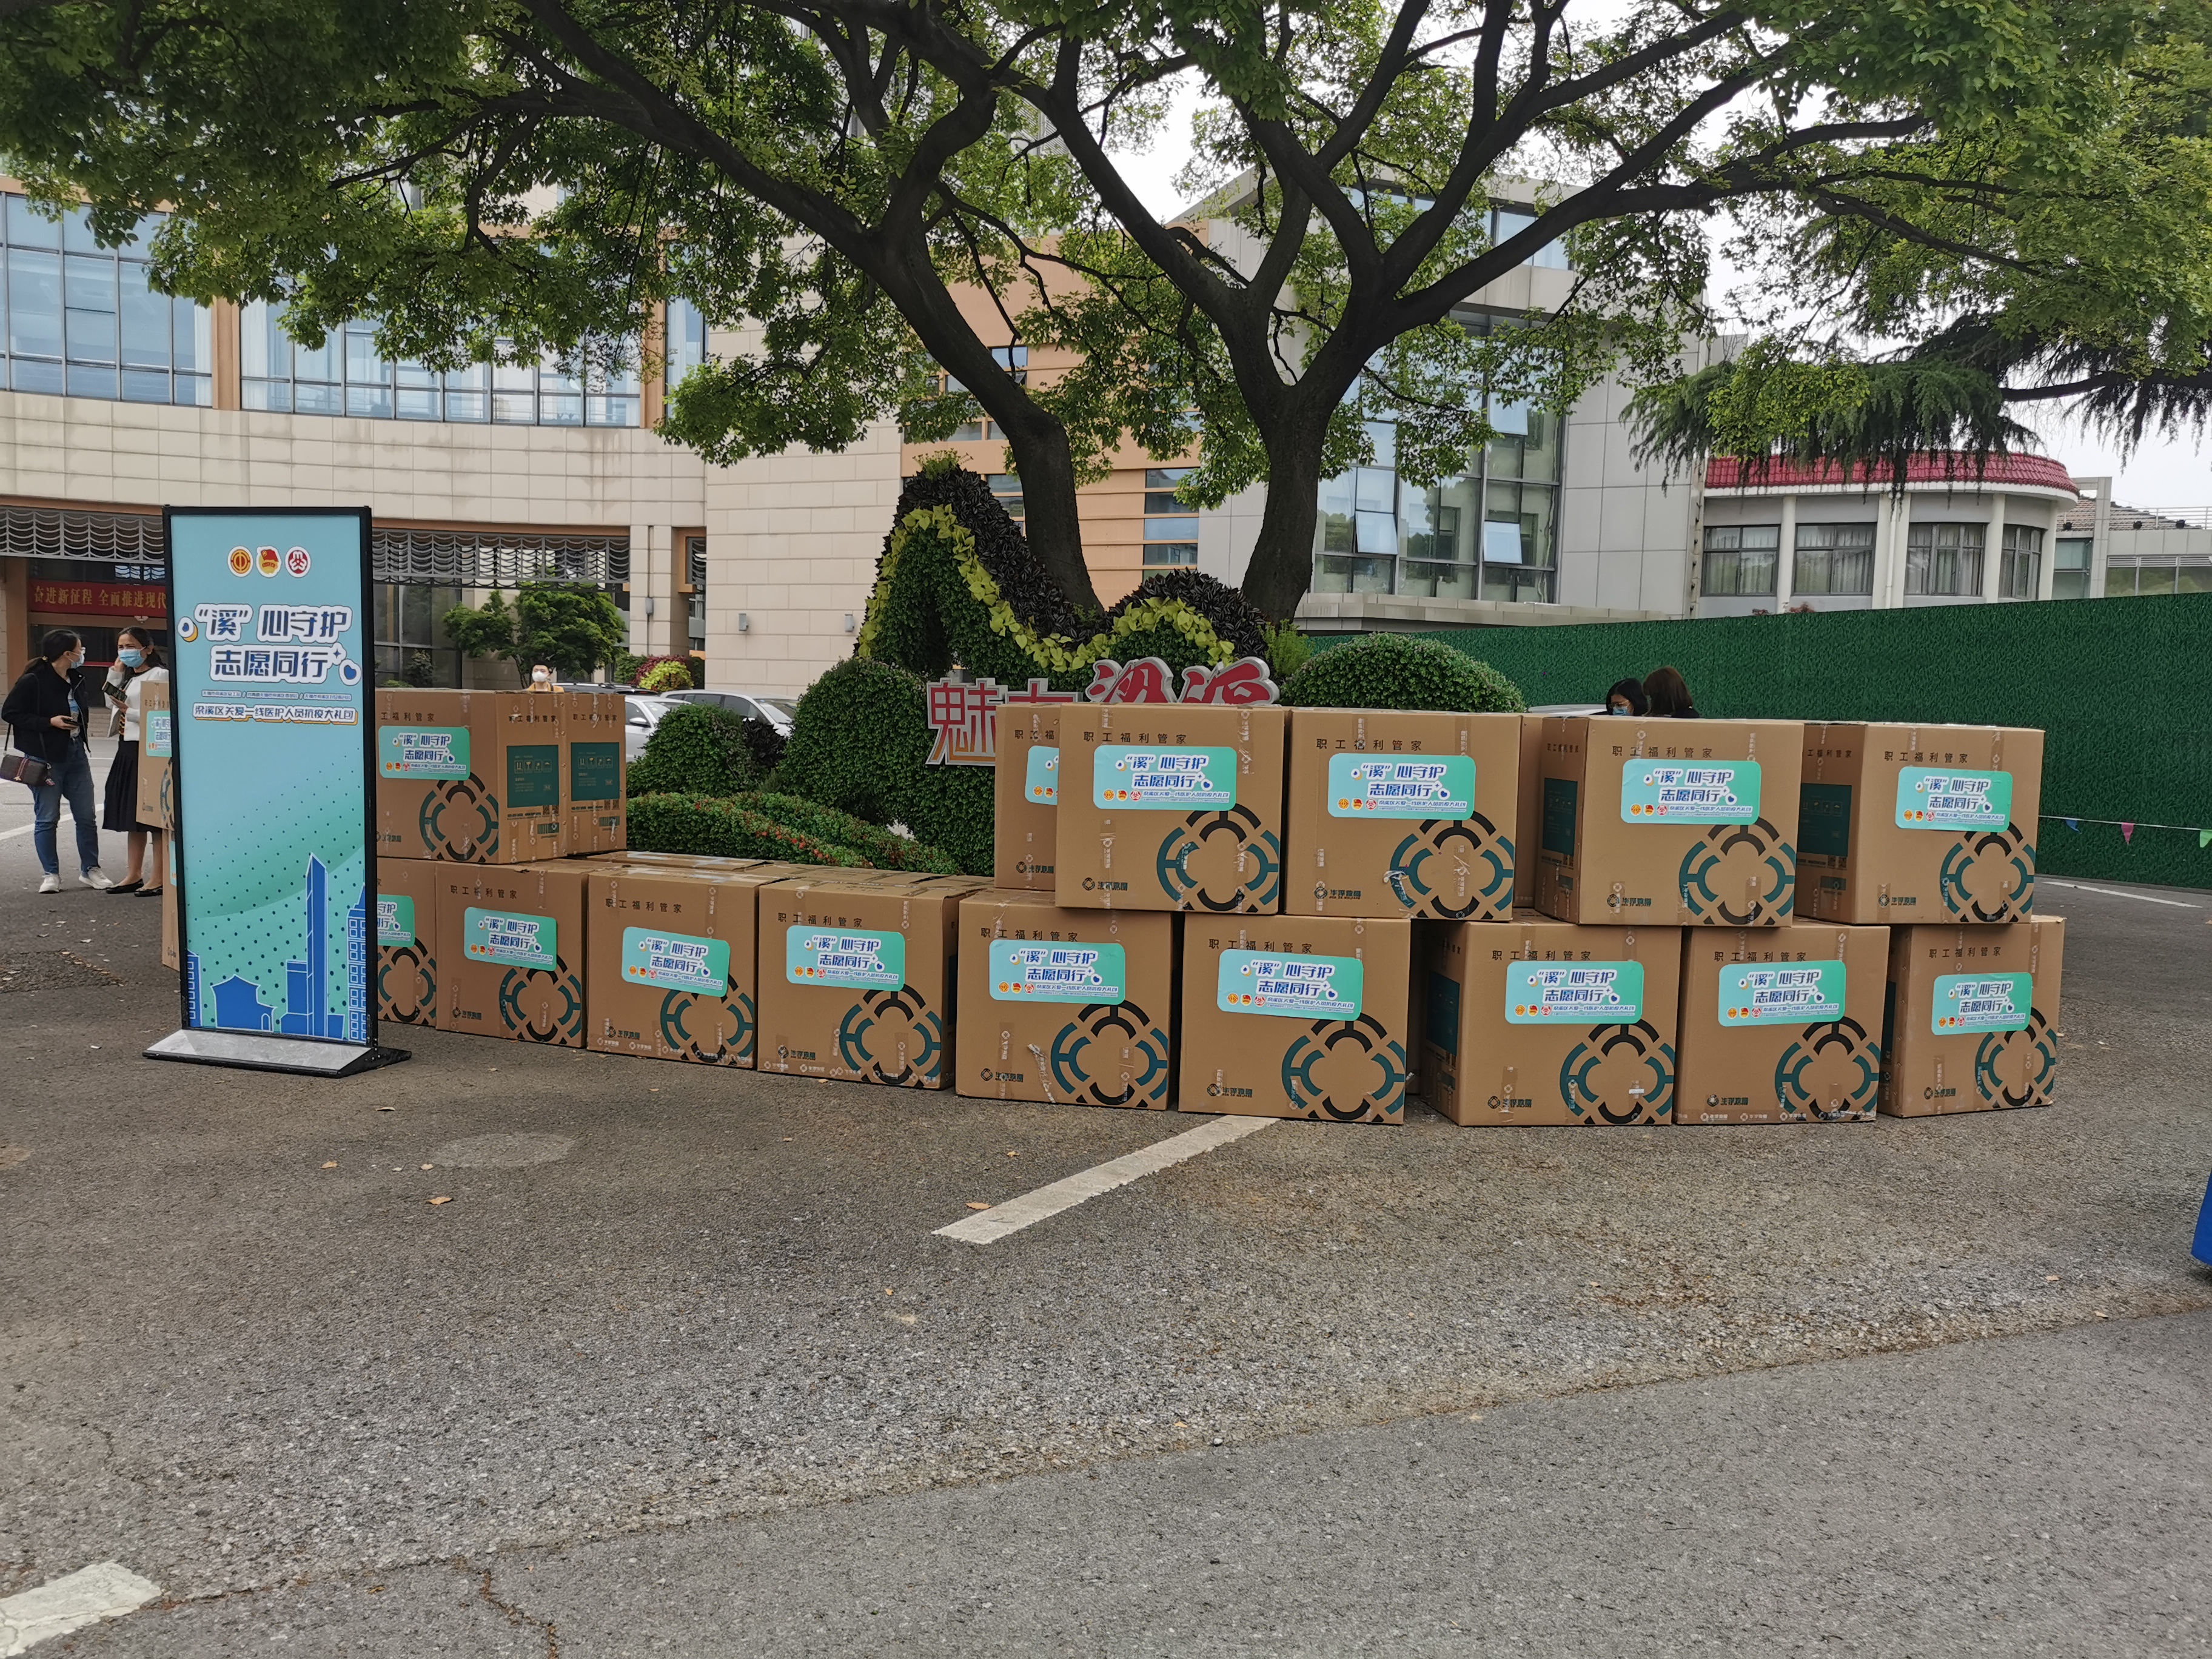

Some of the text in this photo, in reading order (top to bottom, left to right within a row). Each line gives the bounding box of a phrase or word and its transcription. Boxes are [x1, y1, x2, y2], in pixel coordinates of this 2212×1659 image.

[33, 585, 167, 609] 奋进新征程 全面推进现代
[215, 650, 329, 678] 志愿同行
[195, 705, 354, 720] 梁溪区关爱一线医护人员抗疫大礼包
[1014, 729, 1054, 740] 职工福
[1083, 731, 1187, 745] 职工福利管家
[1316, 738, 1423, 751] 职工福利管家
[1612, 745, 1712, 758] 职工福利管家
[405, 750, 444, 761] 志愿同行
[1884, 751, 1968, 763] 职工福利管家
[1133, 773, 1196, 788] 志愿同行
[1369, 783, 1433, 797] 志愿同行
[1661, 788, 1721, 802] 志愿同行
[1929, 796, 1979, 809] 志愿同行
[451, 885, 517, 899] 职工福利管家
[605, 898, 682, 914] 职工福利管家
[777, 912, 863, 928] 职工福利管家
[980, 927, 1078, 942] 职工福利管家
[489, 934, 531, 950] 志愿同行
[1208, 938, 1313, 954] 职工福利管家
[1492, 950, 1592, 961] 职工福利管家
[1714, 951, 1807, 962] 职工福利管家
[1928, 946, 2002, 959] 职工福利管家
[651, 956, 698, 974] 志愿同行
[819, 954, 871, 969] 志愿同行
[1027, 968, 1087, 982] 志愿同行
[1258, 980, 1322, 997] 志愿同行
[1544, 988, 1604, 1002] 志愿同行
[1755, 989, 1810, 1004] 志愿同行
[1960, 1000, 2003, 1013] 志愿同行
